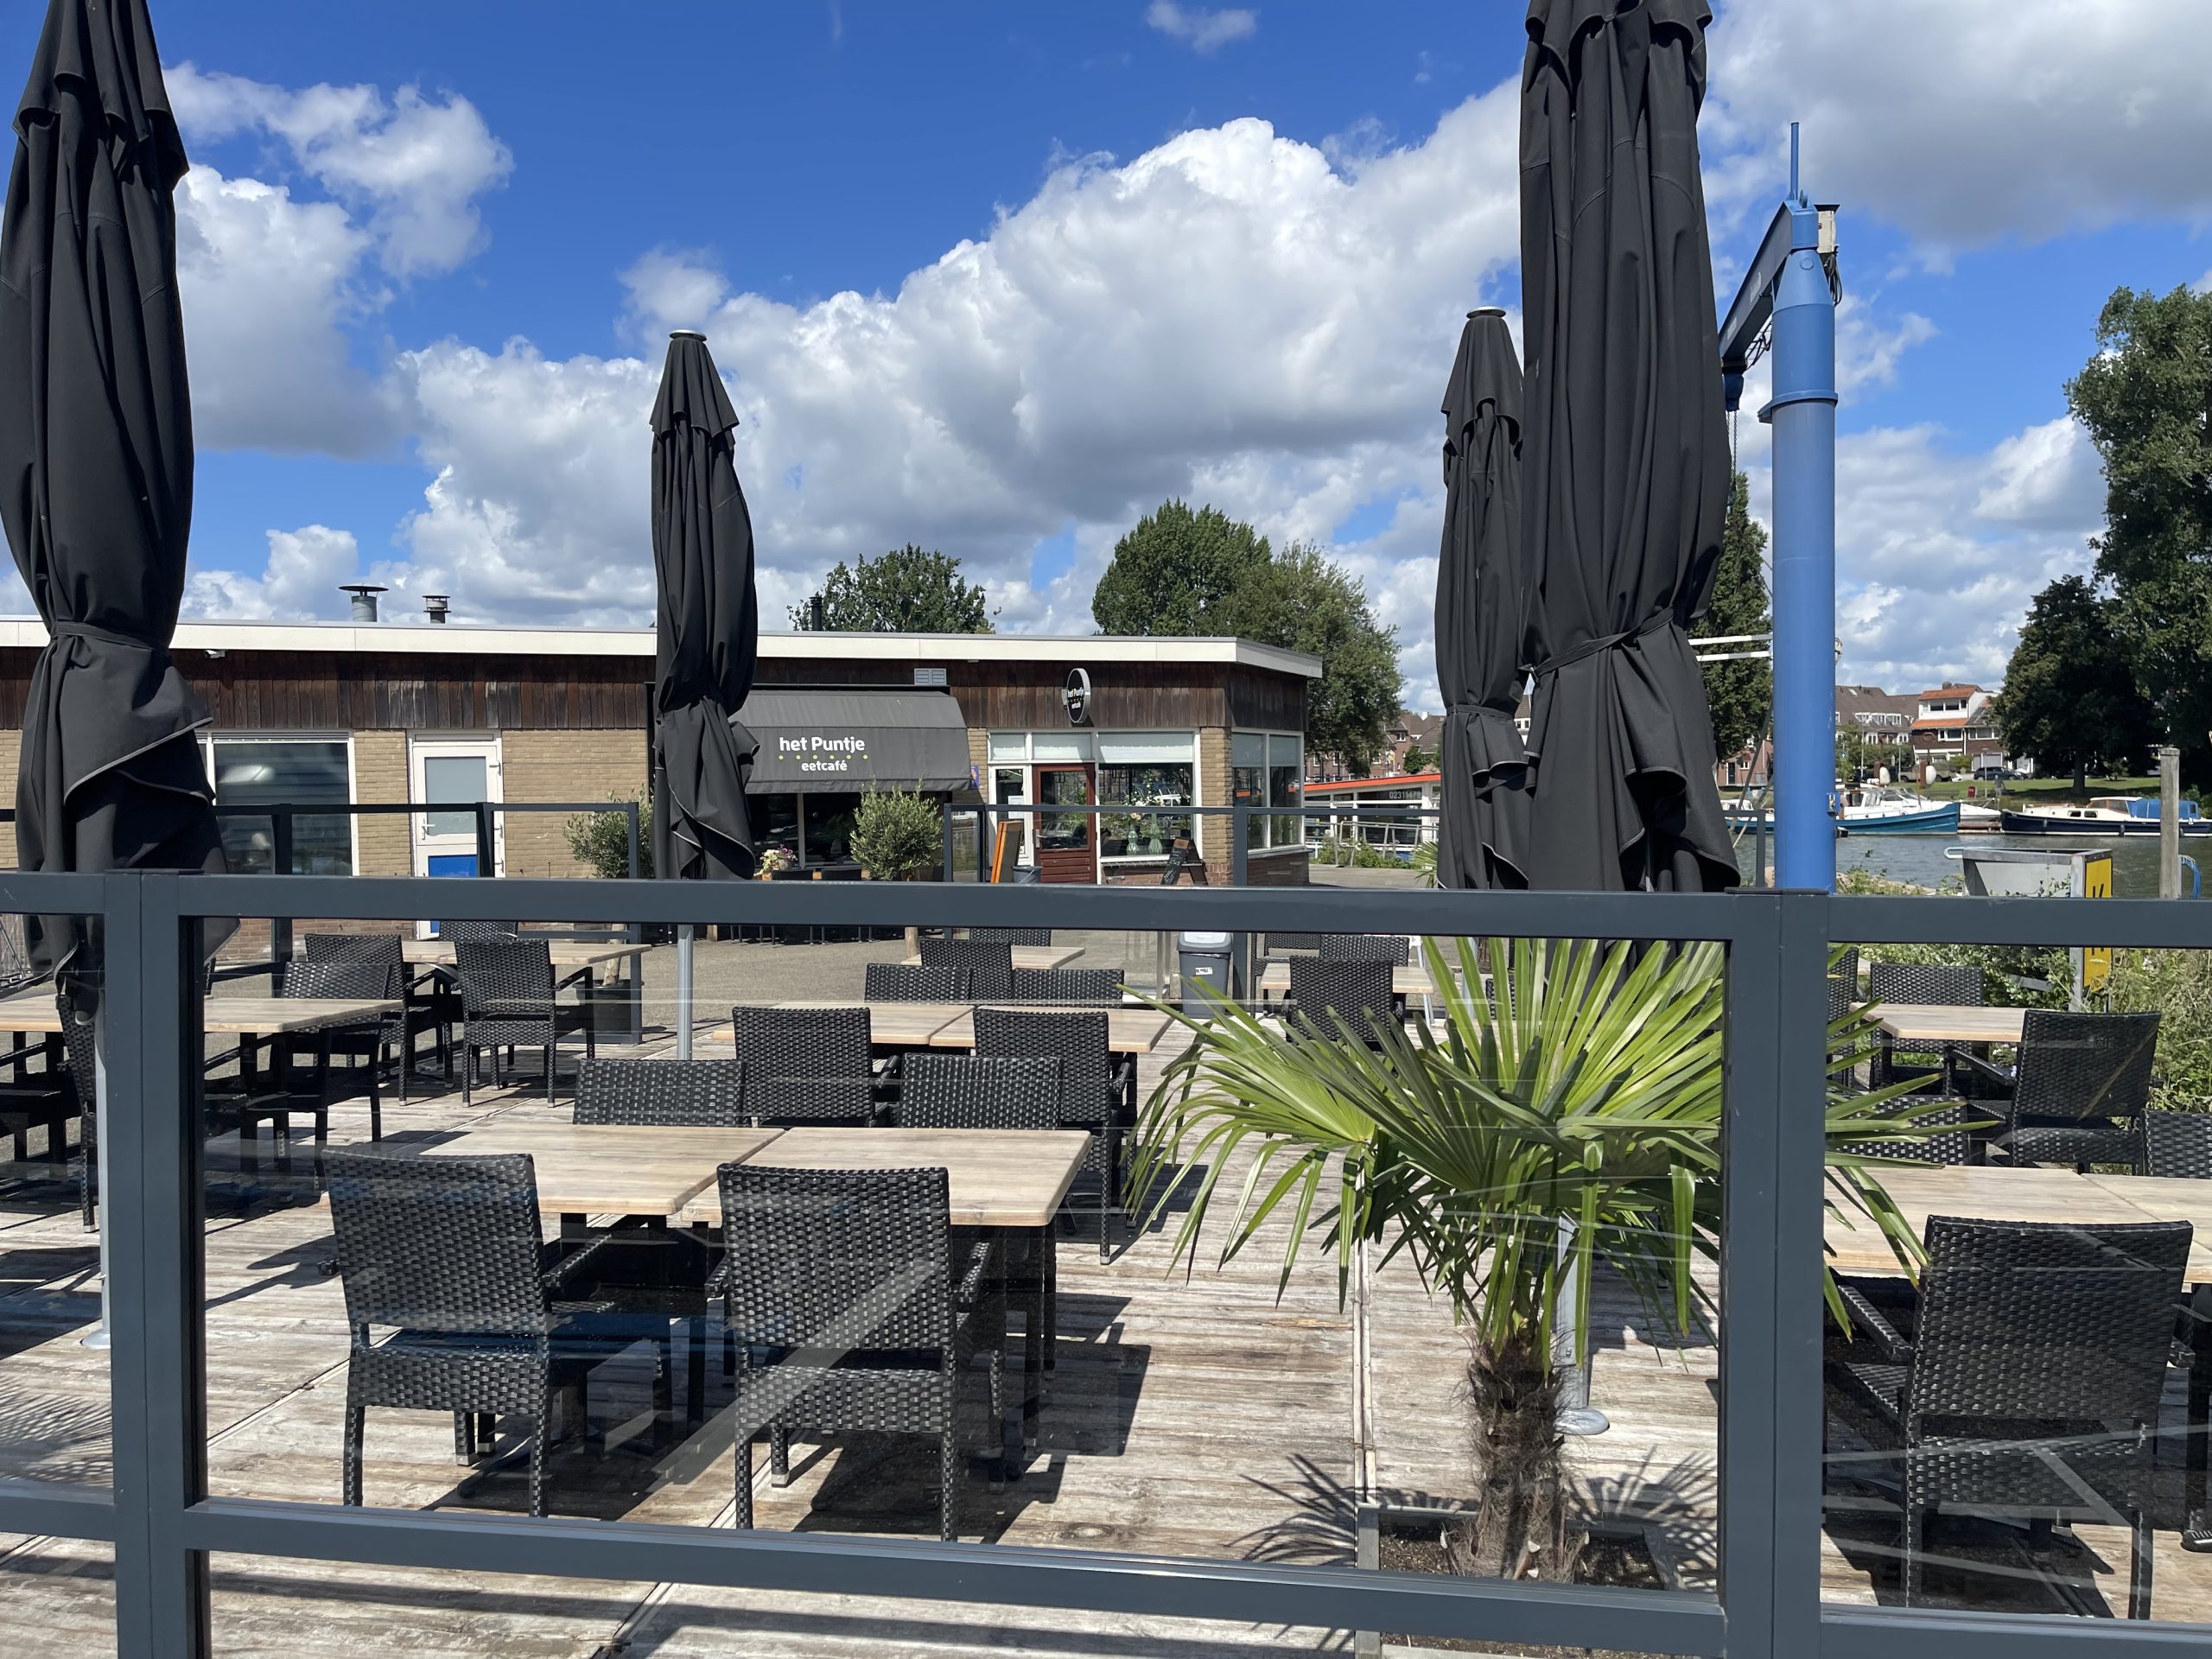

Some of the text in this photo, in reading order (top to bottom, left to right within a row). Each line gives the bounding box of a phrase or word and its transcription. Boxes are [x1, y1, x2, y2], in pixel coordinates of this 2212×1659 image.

[779, 736, 865, 753] het Puntje
[801, 760, 848, 771] eetcafé
